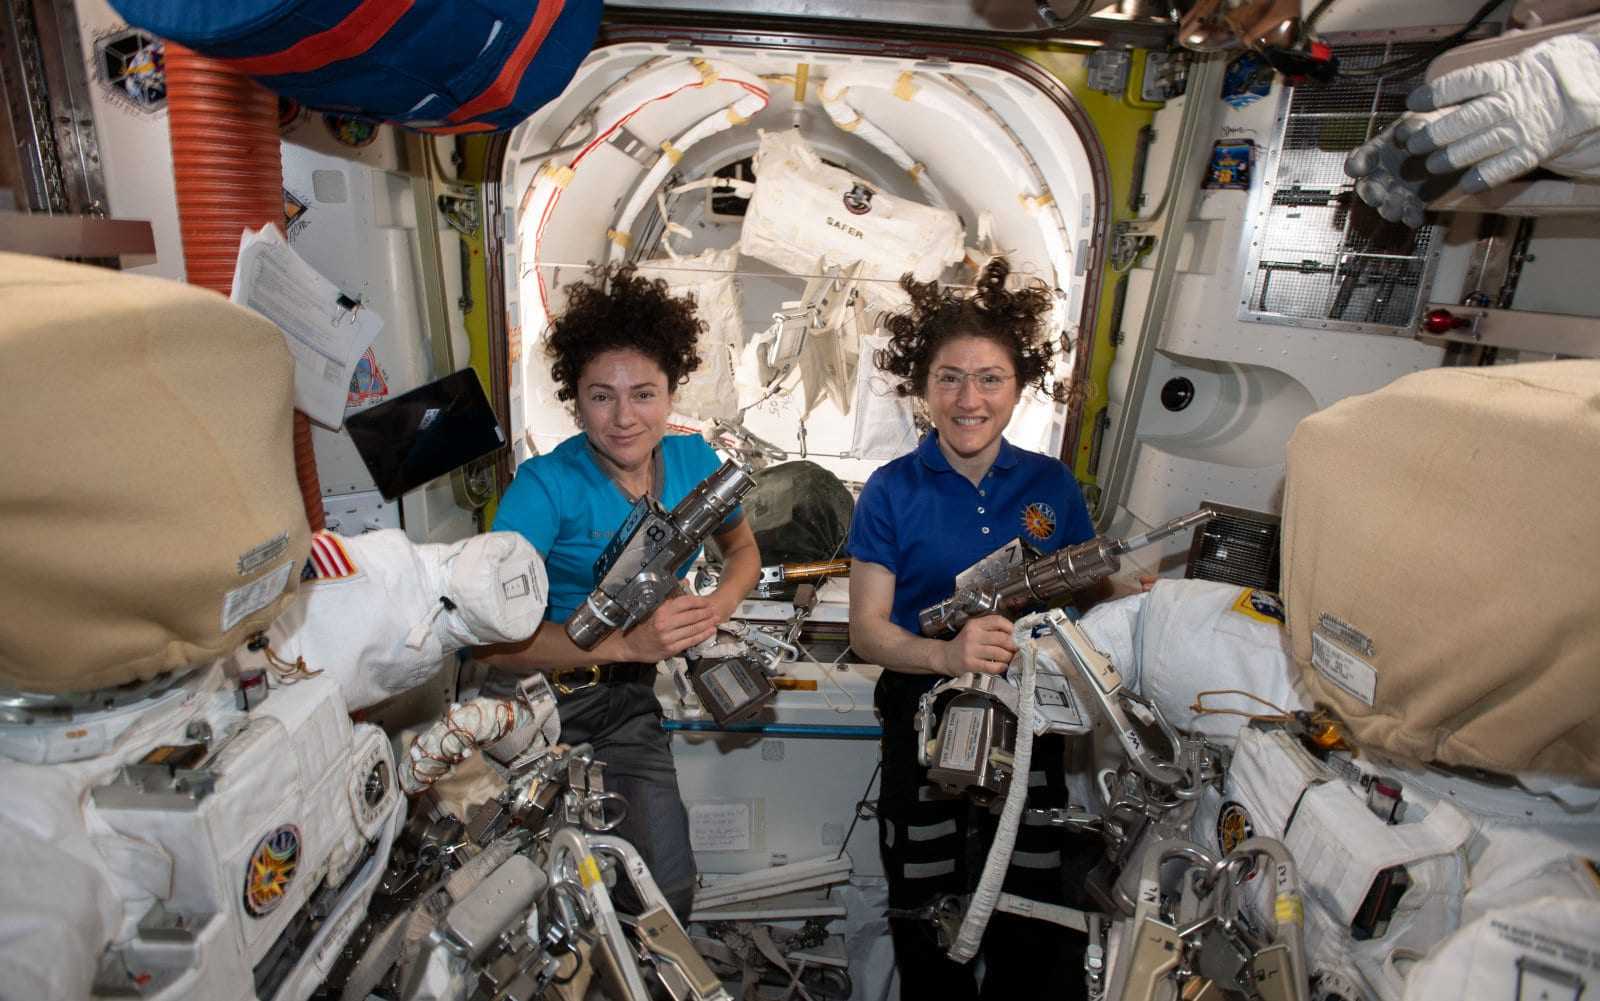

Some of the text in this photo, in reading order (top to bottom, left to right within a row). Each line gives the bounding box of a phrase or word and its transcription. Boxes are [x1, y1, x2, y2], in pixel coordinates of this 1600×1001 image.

[826, 216, 865, 240] SAFER
[647, 525, 665, 542] 8
[1005, 545, 1017, 563] 7
